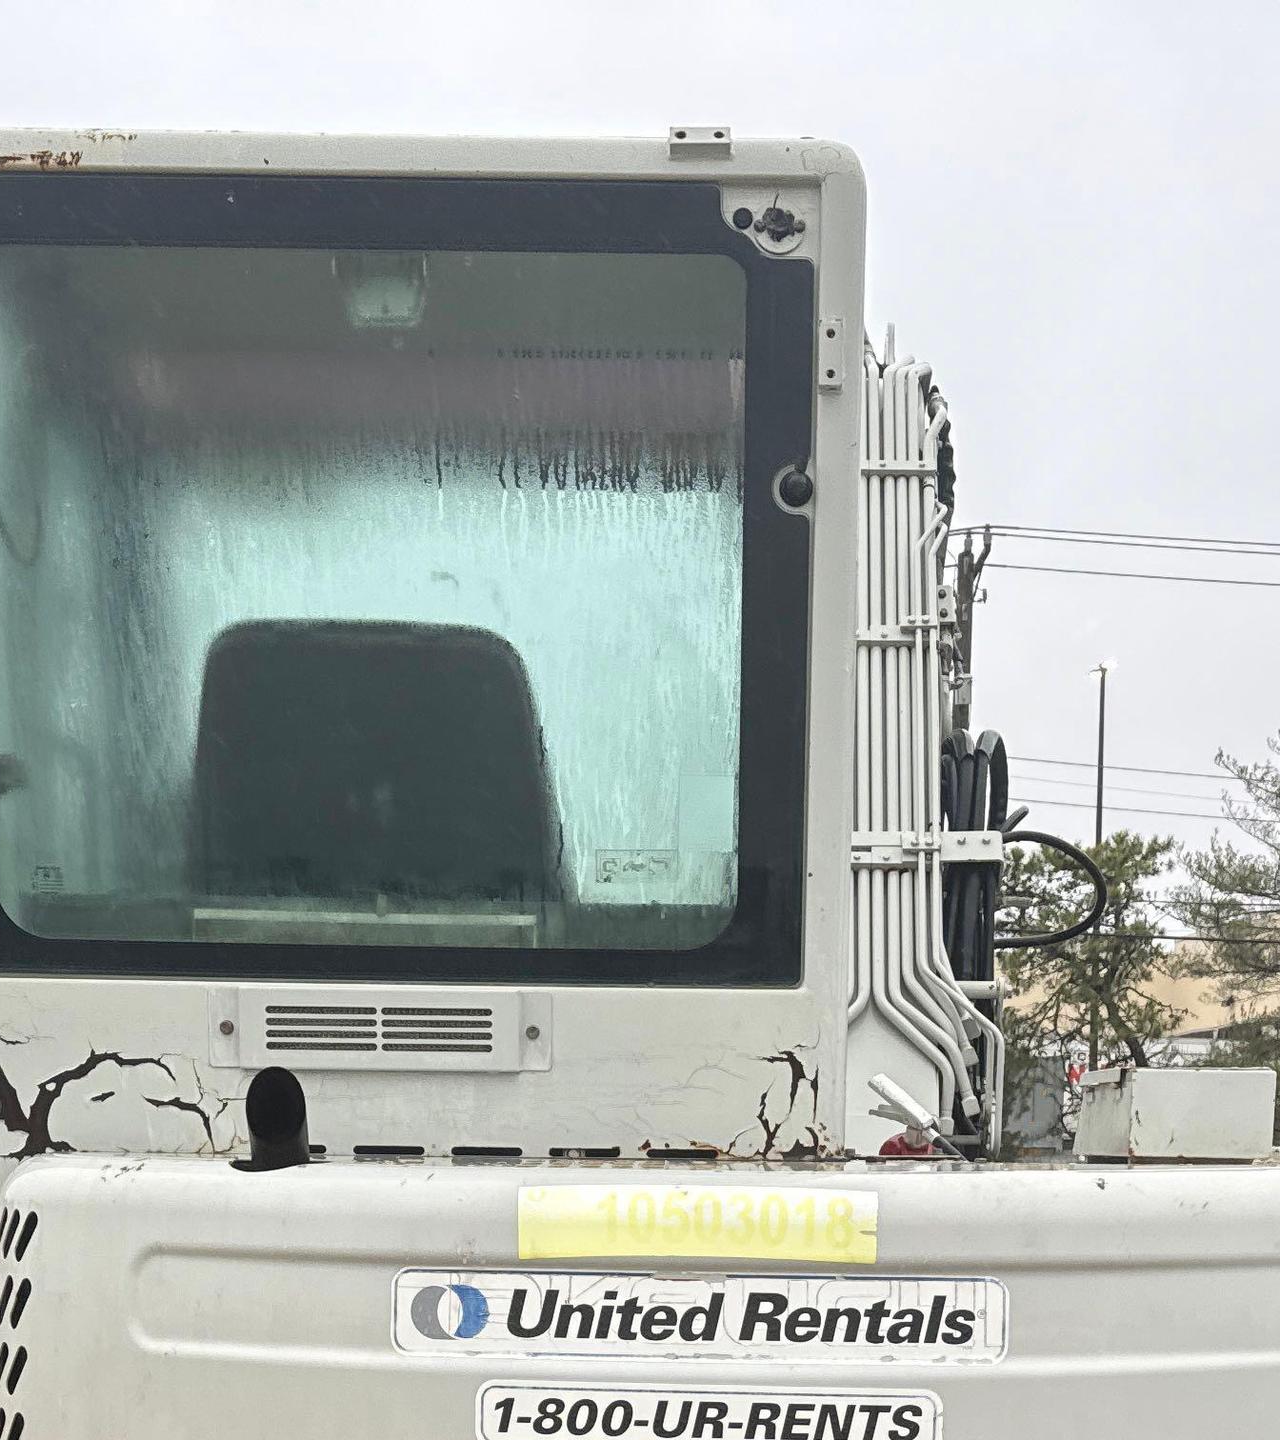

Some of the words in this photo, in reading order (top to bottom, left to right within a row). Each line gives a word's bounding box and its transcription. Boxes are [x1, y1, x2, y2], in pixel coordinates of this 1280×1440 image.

[596, 1189, 855, 1249] 10503018
[506, 1288, 726, 1342] United
[738, 1291, 976, 1345] Rentals
